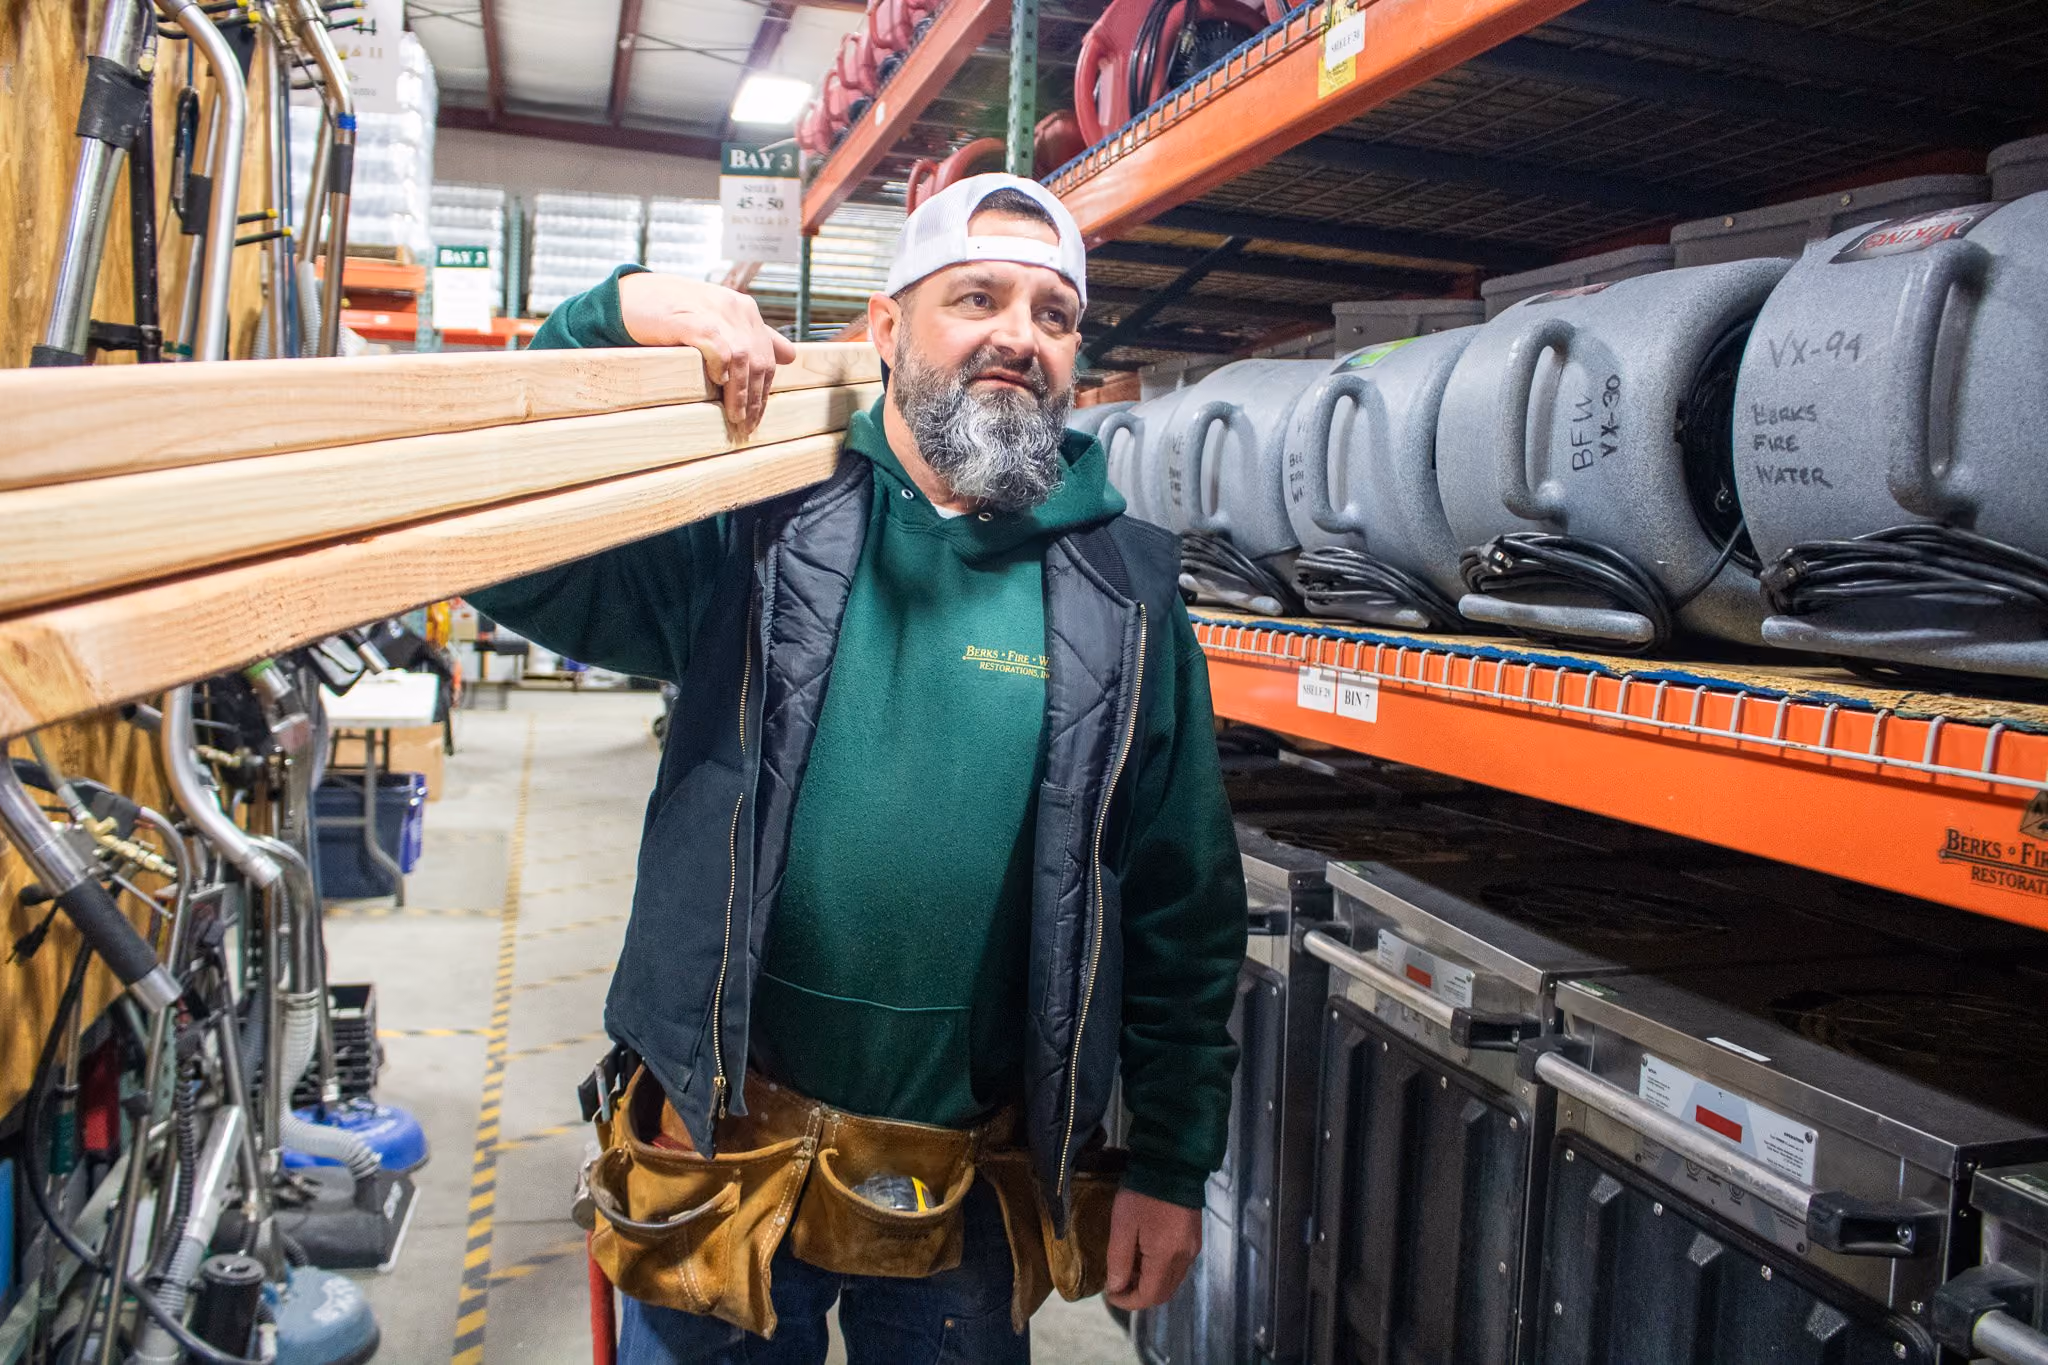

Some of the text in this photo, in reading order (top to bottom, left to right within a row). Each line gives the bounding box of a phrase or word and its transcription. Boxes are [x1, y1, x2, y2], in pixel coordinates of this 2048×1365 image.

[730, 149, 793, 170] BAY 3
[767, 196, 784, 211] 50
[1769, 329, 1863, 369] VX-94
[1600, 374, 1621, 459] VX-30
[1570, 392, 1594, 471] BFW
[1754, 434, 1800, 453] FIRE
[1756, 464, 1834, 490] WATER
[966, 645, 1050, 667] BERKS FIRE W
[979, 661, 1040, 679] RESTORATIONS,
[1344, 688, 1362, 706] BIN
[1945, 828, 2048, 869] BERKS FIR
